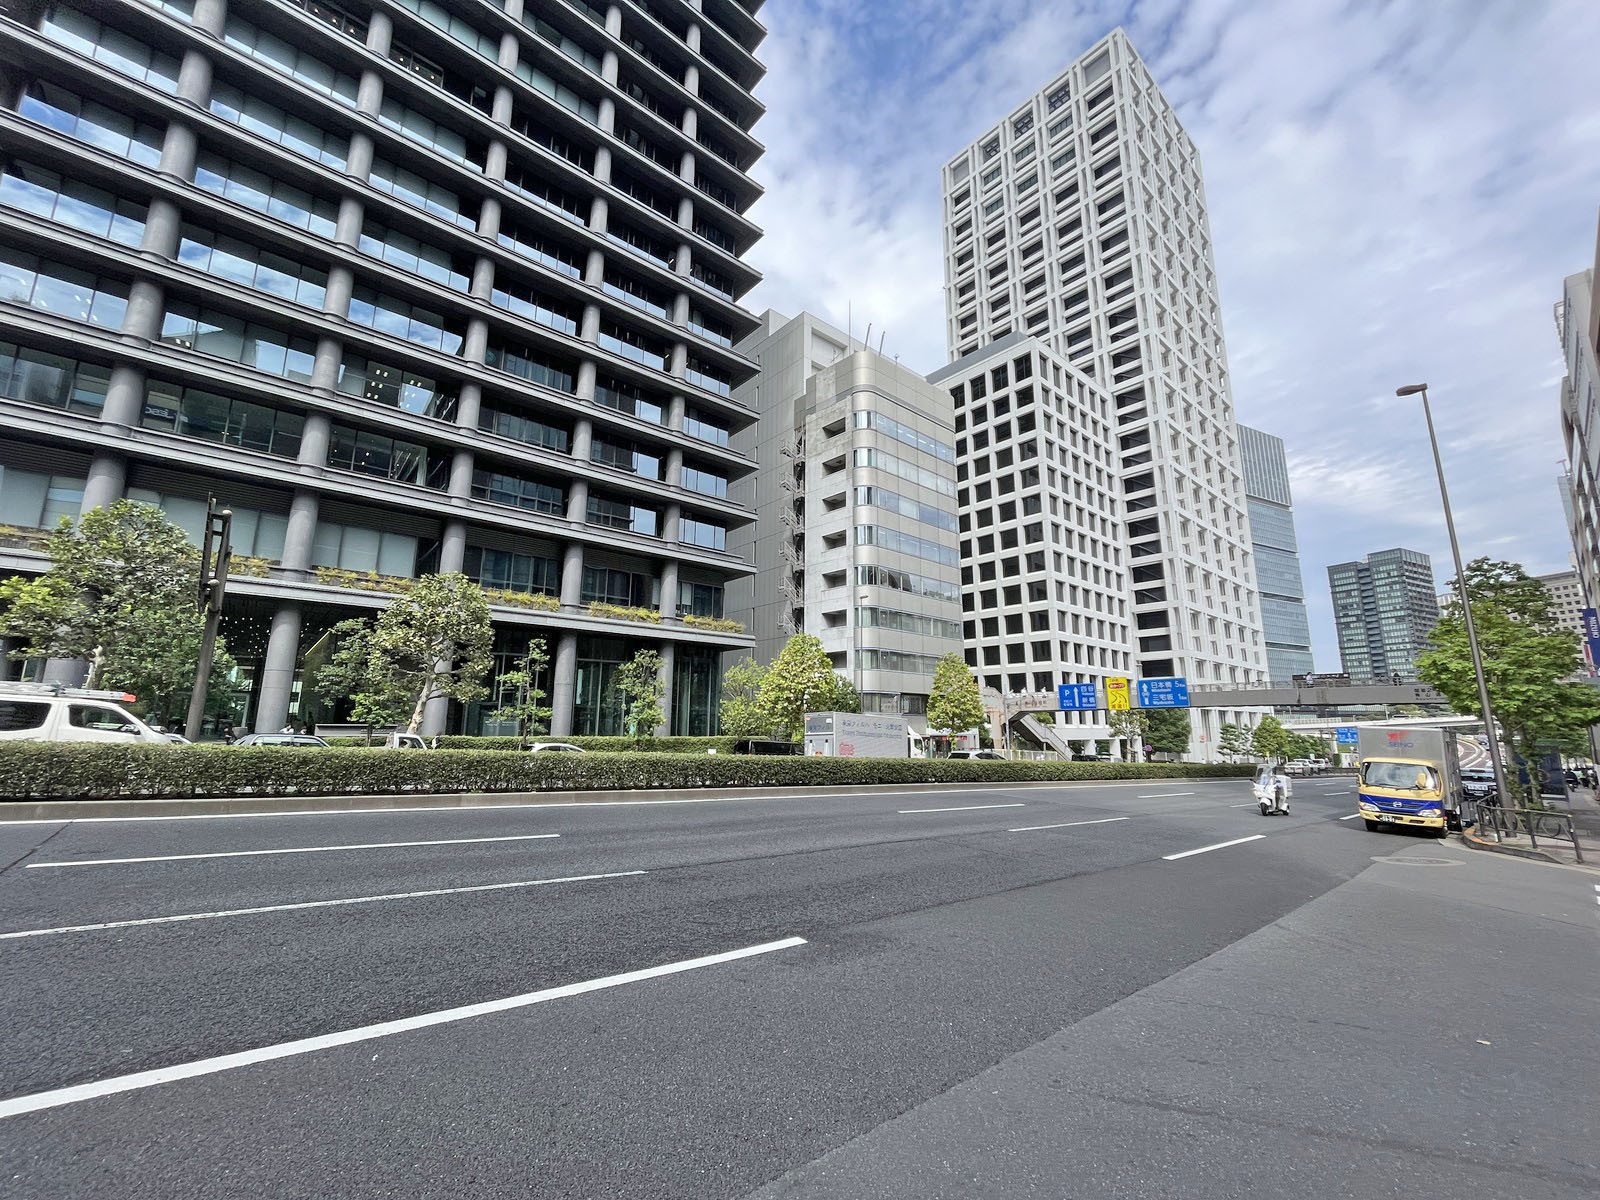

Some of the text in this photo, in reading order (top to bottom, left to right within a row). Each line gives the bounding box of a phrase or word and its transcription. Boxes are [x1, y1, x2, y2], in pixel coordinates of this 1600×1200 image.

[1151, 681, 1172, 689] 日本橋
[1064, 689, 1070, 697] P
[1152, 693, 1174, 701] 三宅坂
